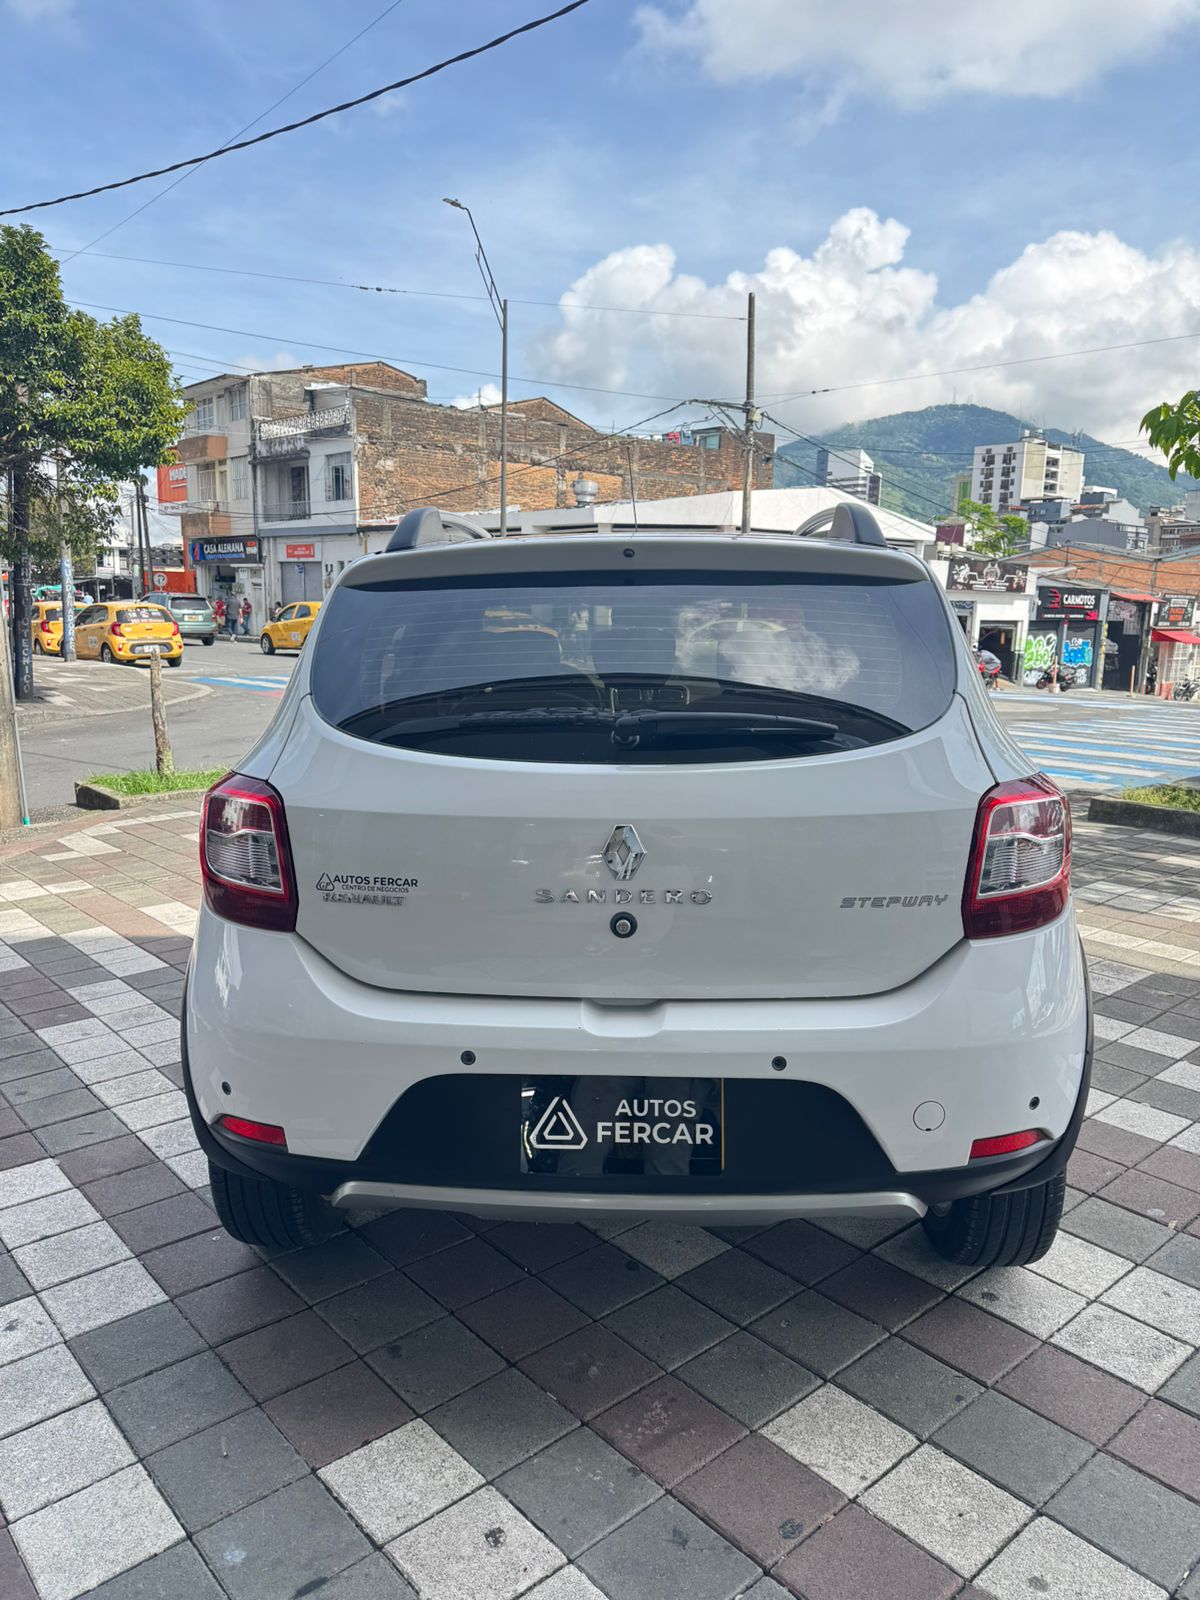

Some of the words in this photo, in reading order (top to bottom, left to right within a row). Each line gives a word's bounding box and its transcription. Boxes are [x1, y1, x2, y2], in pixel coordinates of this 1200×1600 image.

[203, 543, 217, 554] CASA
[217, 542, 244, 553] ALEMANA
[1063, 594, 1096, 605] CARMOTOS
[333, 875, 370, 885] AUTOS
[373, 877, 418, 887] FERCAR
[323, 892, 404, 906] RENAULT
[535, 889, 713, 905] SANDERO
[840, 894, 949, 908] STEPWAY
[615, 1099, 697, 1118] AUTOS
[597, 1122, 713, 1144] FERCAR
